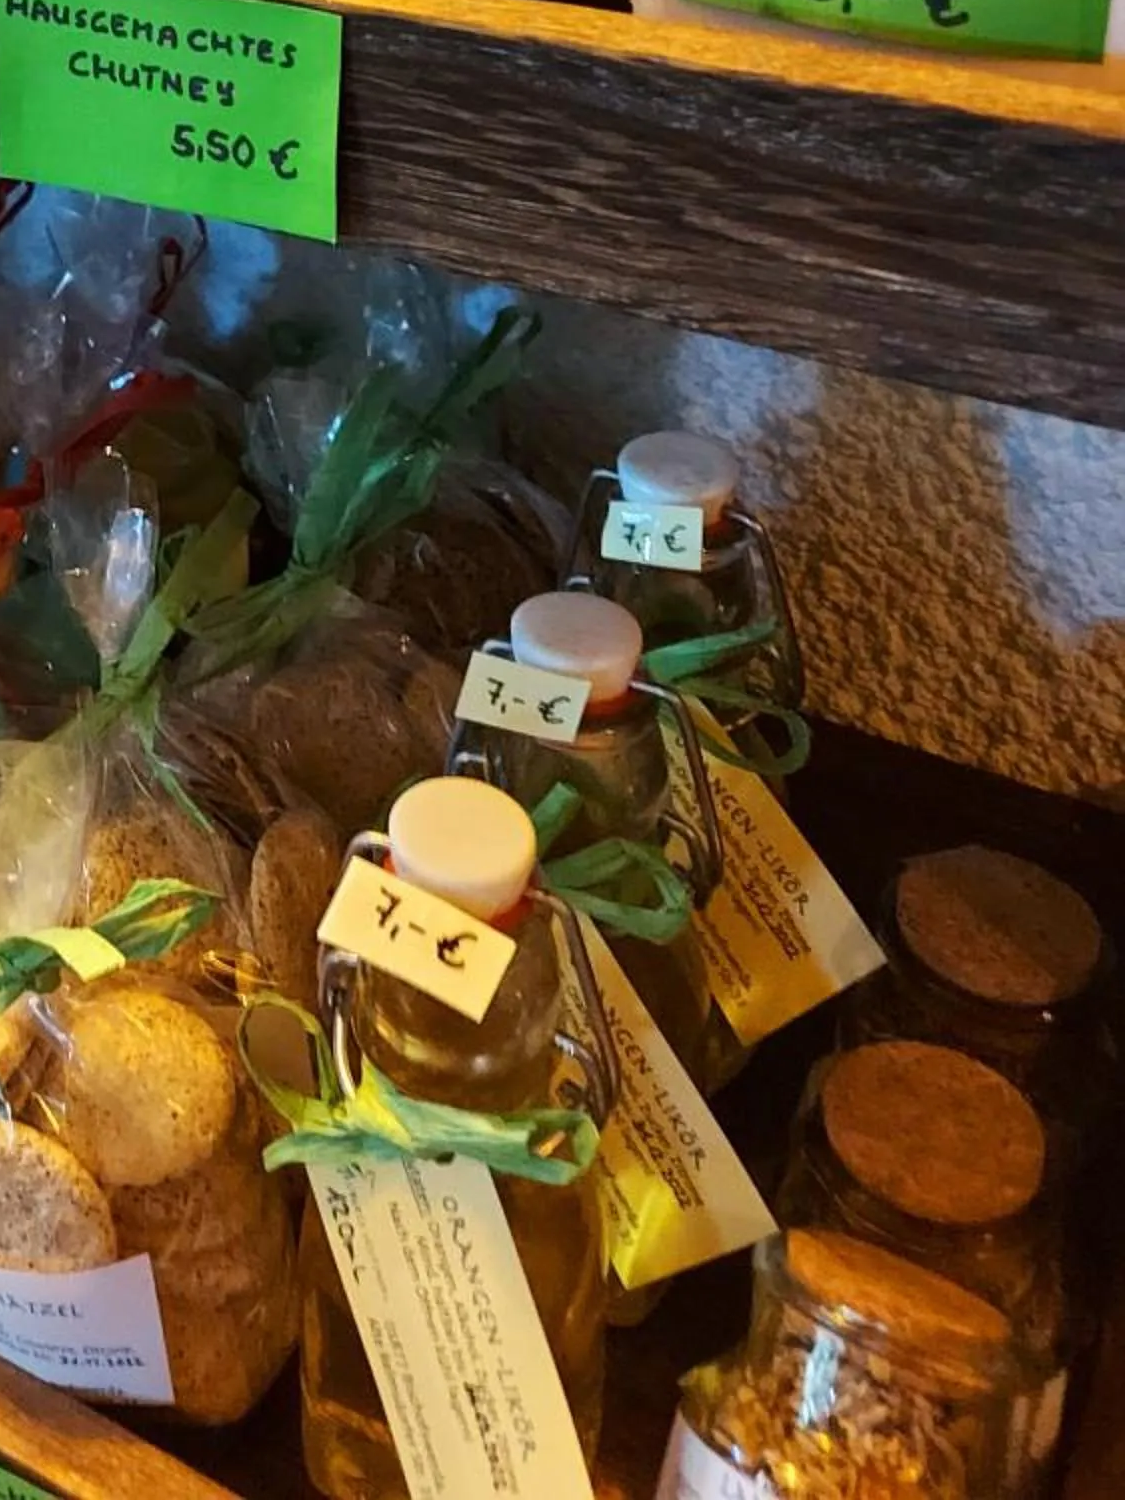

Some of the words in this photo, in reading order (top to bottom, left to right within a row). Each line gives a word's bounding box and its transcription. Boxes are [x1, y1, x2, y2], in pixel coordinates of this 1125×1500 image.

[68, 50, 235, 107] CHUTNEY
[170, 123, 256, 170] 5,50
[268, 139, 301, 181] €
[537, 695, 572, 725] €
[436, 931, 479, 970] €
